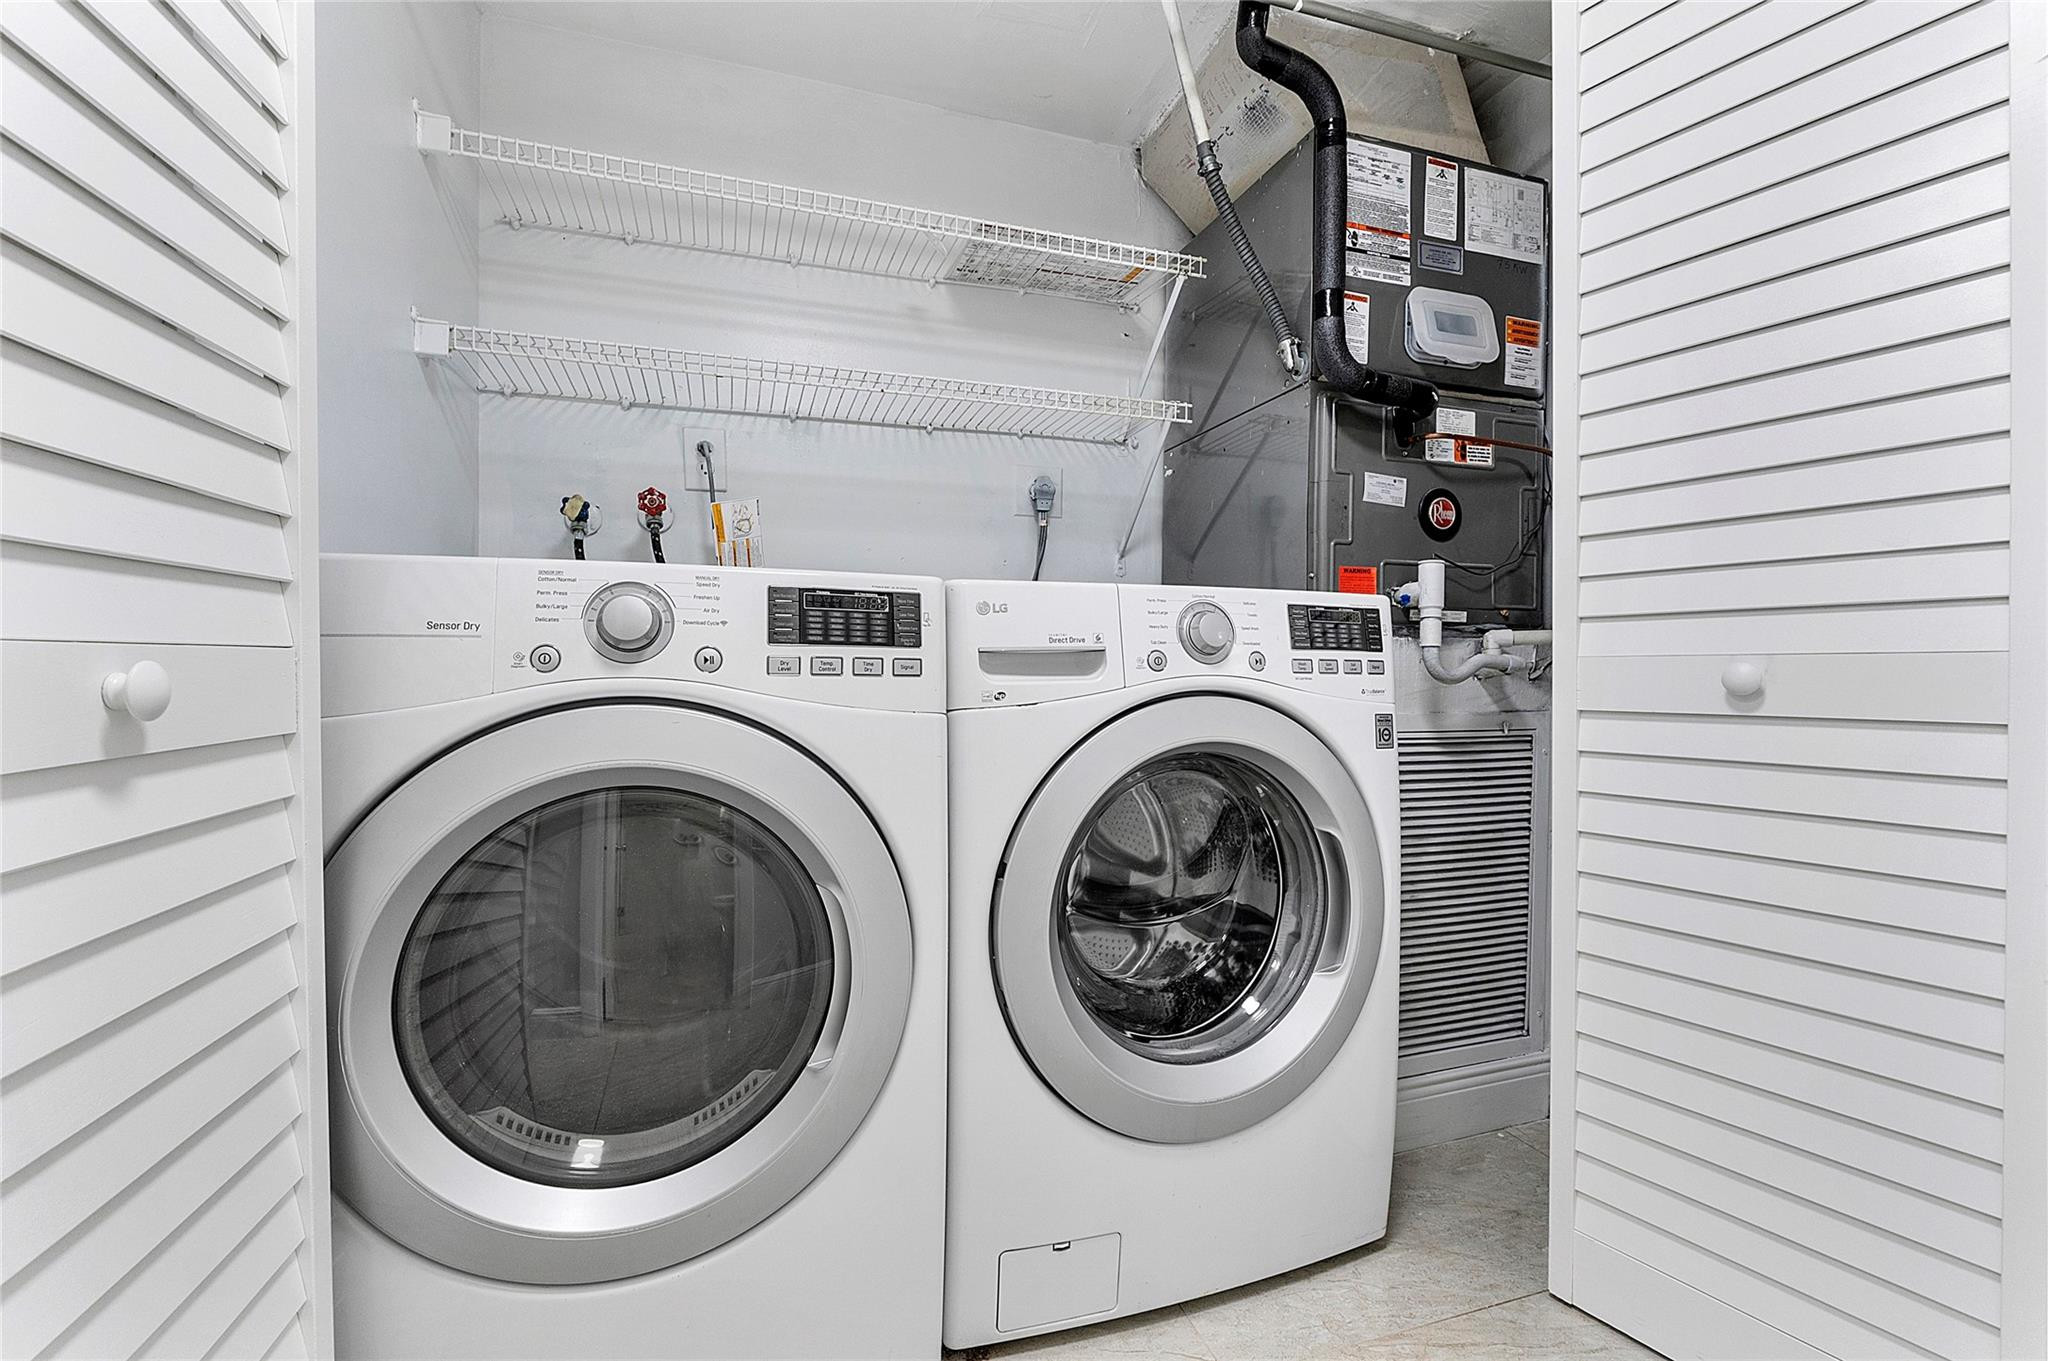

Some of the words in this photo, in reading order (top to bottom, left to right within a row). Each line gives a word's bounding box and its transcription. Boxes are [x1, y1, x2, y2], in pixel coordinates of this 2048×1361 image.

[992, 603, 1008, 613] LG
[426, 620, 461, 630] Sensor
[463, 621, 481, 632] Dry
[1378, 728, 1391, 742] 10
